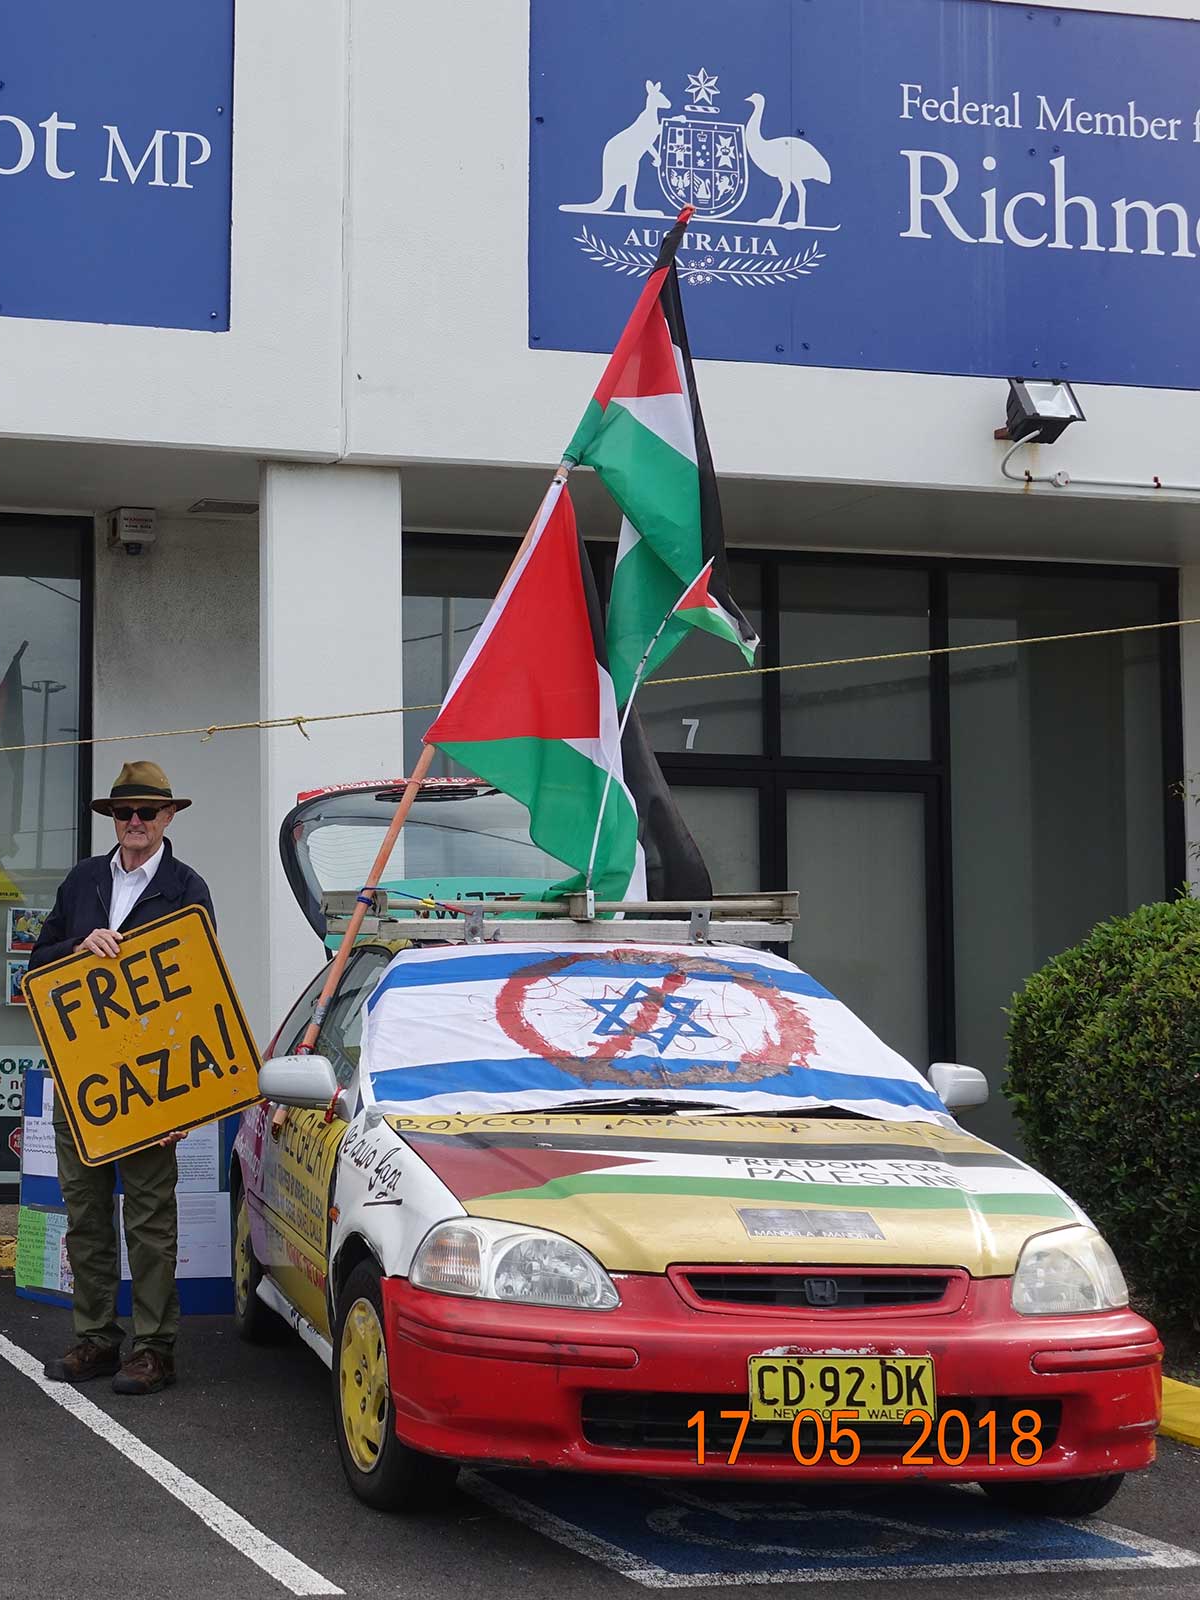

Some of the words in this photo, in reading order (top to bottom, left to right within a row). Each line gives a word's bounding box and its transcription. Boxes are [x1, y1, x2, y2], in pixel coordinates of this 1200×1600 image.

[899, 83, 1023, 129] Federal
[1035, 95, 1182, 141] Member
[99, 125, 212, 189] MP
[899, 150, 1200, 258] Richm
[623, 228, 780, 257] AUTRALIA
[681, 718, 700, 750] 7
[51, 938, 193, 1042] FREE
[77, 1003, 240, 1126] GAZA!
[395, 1117, 591, 1132] BOYCOTT
[614, 1116, 811, 1131] APARTHEID
[821, 1121, 965, 1140] ISRAEL
[725, 1157, 877, 1170] FREEDOM
[887, 1162, 952, 1176] FOR
[748, 1167, 978, 1193] PALESTINE
[867, 1409, 910, 1420] WALE
